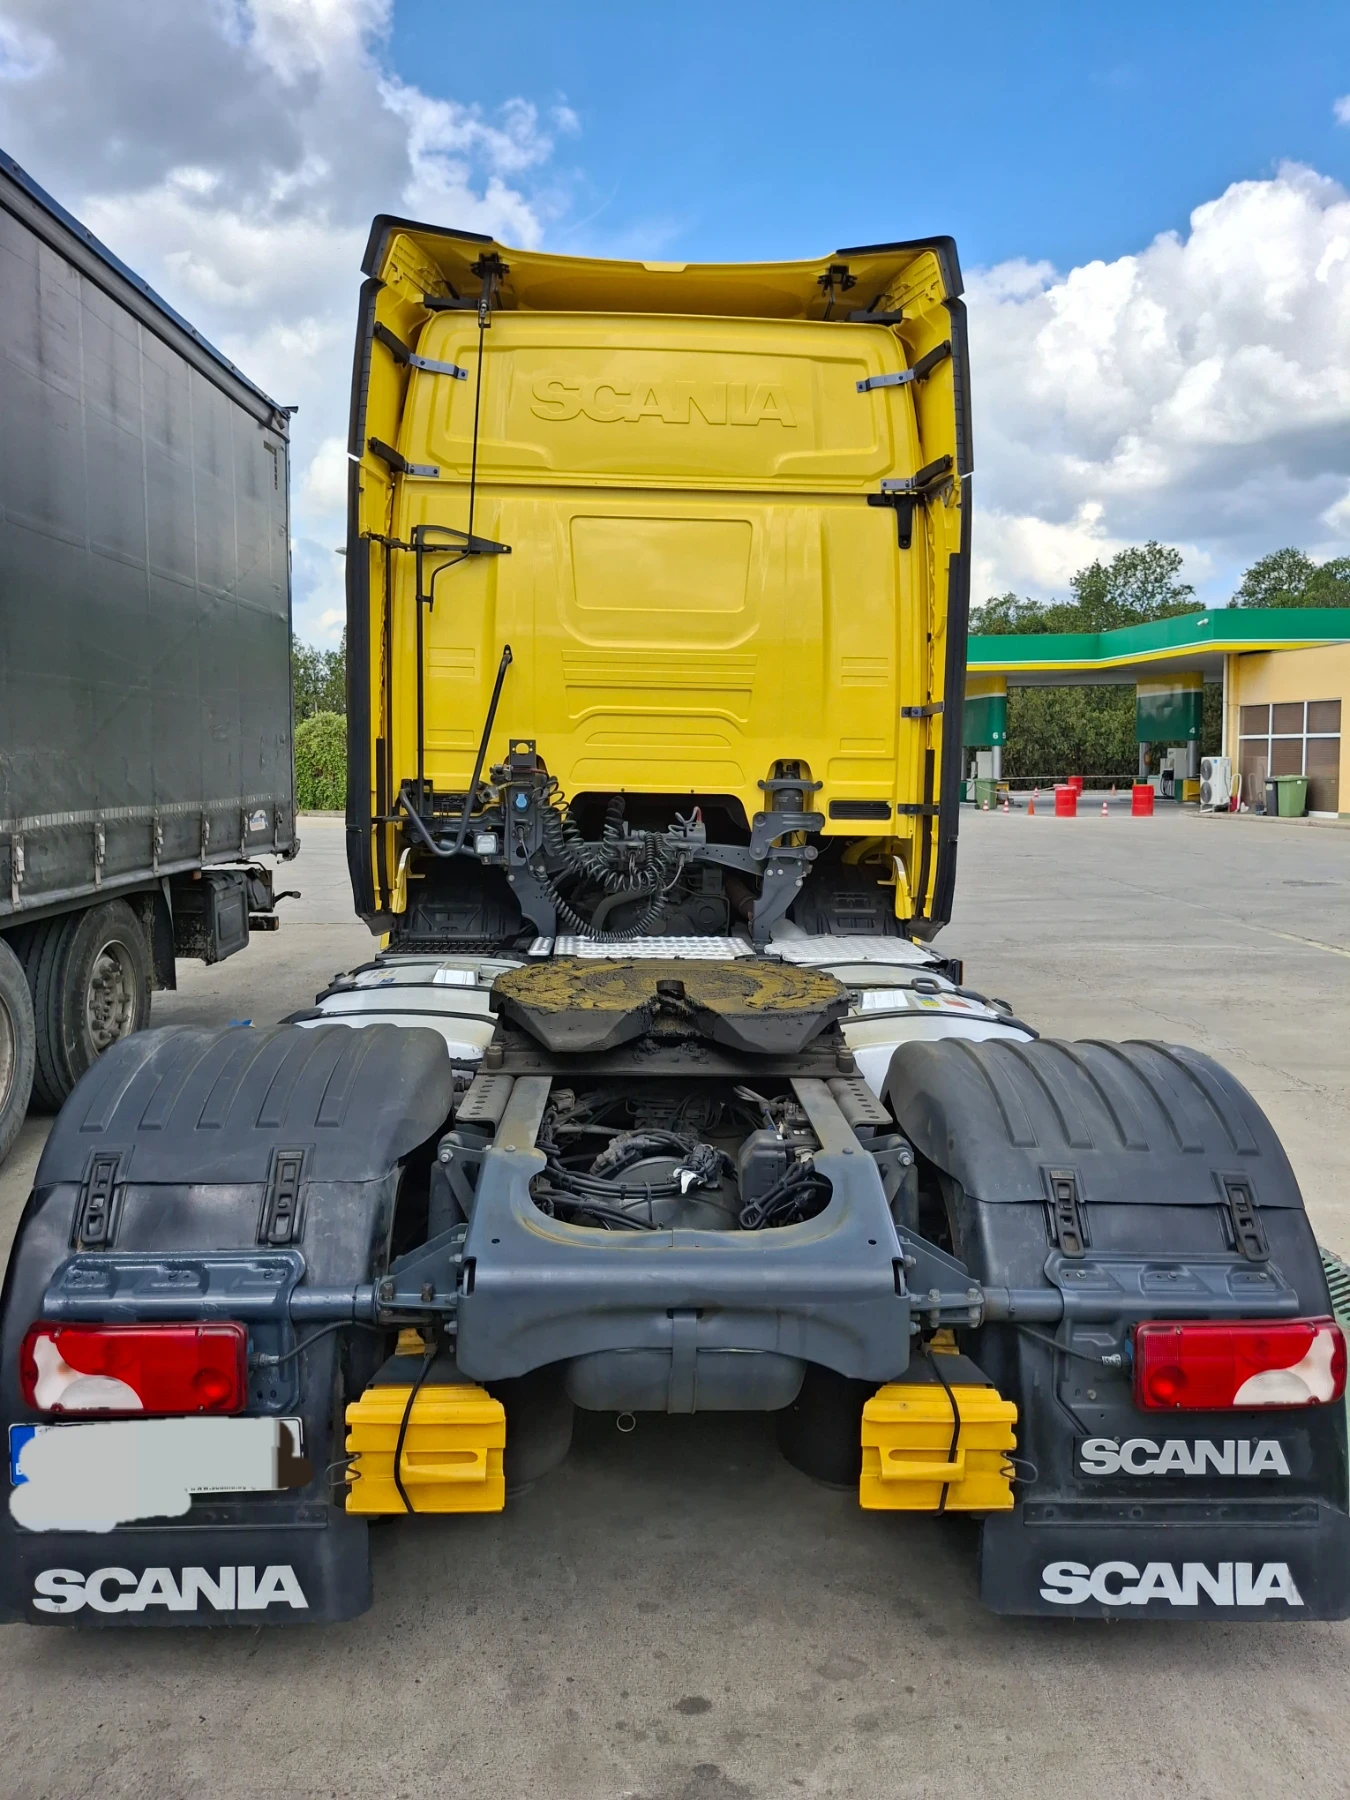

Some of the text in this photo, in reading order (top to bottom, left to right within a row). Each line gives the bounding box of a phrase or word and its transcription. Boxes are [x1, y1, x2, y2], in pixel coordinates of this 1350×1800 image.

[530, 376, 797, 428] SCANIA
[992, 732, 999, 740] 6
[1079, 1438, 1291, 1475] SCANIA
[32, 1565, 309, 1613] SCANIA
[1040, 1561, 1305, 1606] SCANIA
